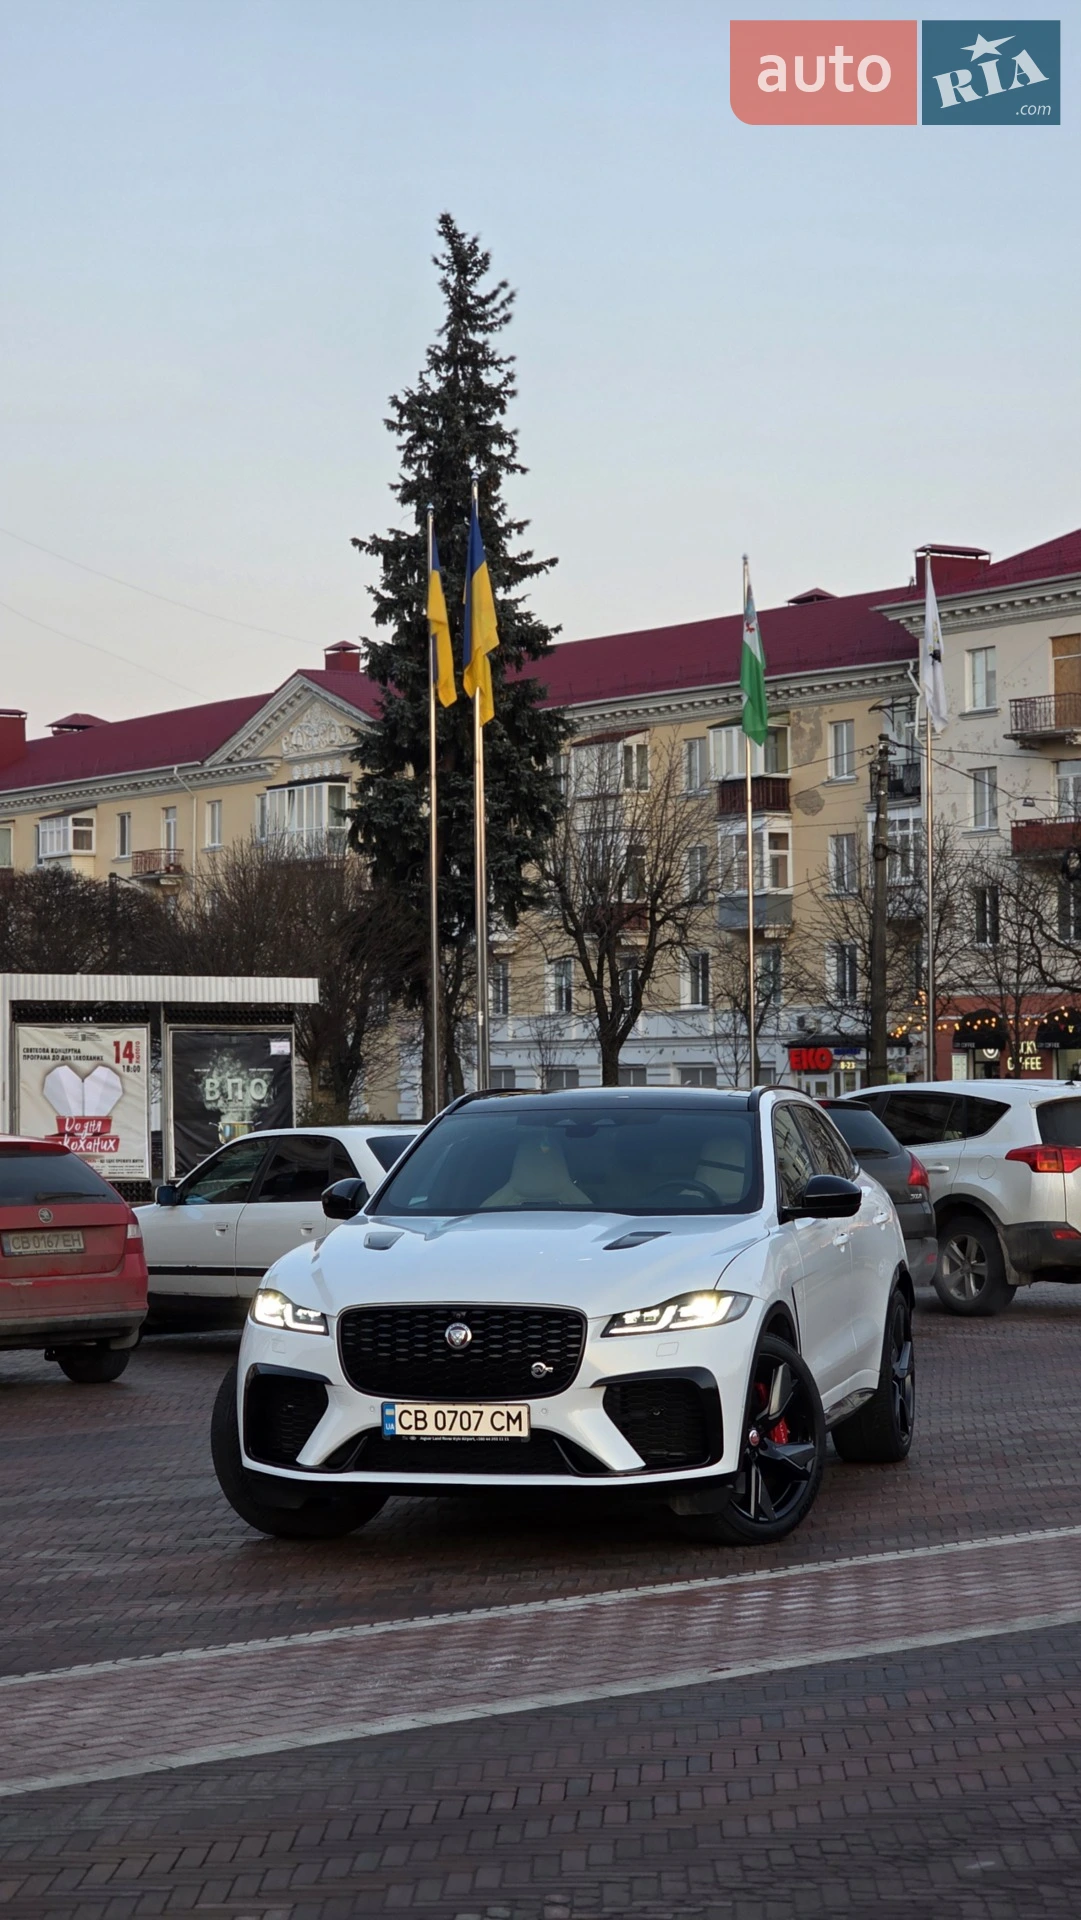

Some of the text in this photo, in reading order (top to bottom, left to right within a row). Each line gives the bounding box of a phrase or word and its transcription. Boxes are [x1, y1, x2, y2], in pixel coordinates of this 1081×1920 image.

[113, 1040, 135, 1064] 14
[122, 1064, 141, 1073] 18:00
[840, 1061, 856, 1070] 8-23
[205, 1078, 268, 1101] ВПО
[33, 1233, 60, 1249] 0167
[398, 1409, 522, 1432] CB 0707 CM
